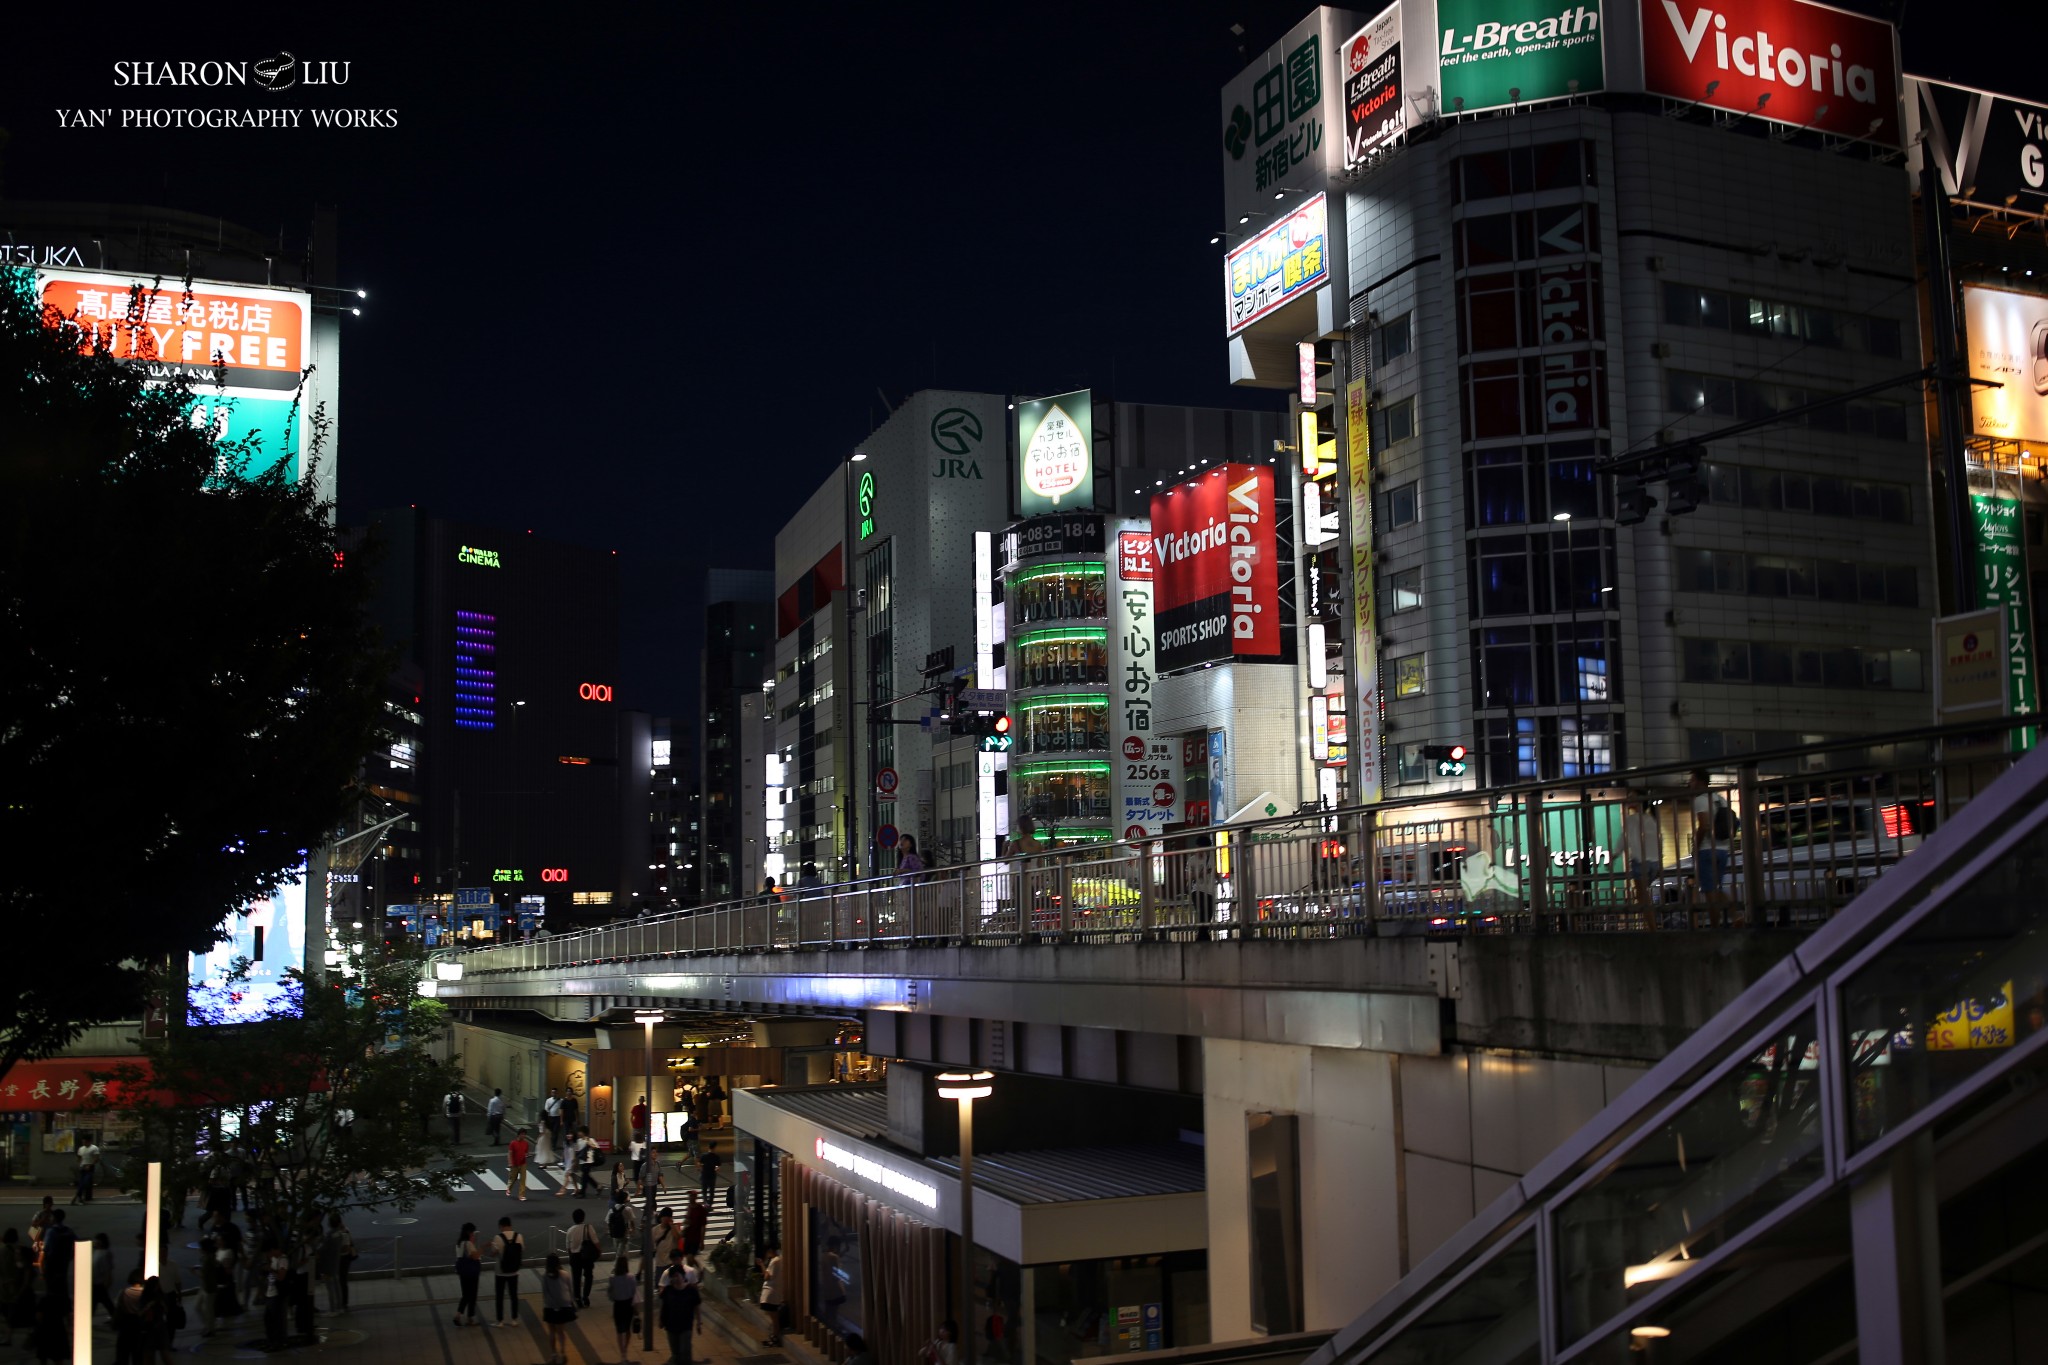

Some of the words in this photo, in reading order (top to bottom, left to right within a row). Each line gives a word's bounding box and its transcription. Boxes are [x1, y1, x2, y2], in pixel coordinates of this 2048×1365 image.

[1440, 53, 1459, 67] feel
[1462, 53, 1478, 64] the
[1481, 47, 1512, 60] earth,
[1515, 39, 1559, 56] open-air
[1562, 33, 1595, 48] sports
[1441, 6, 1598, 56] L-Breath
[1662, 0, 1875, 104] Victoria
[1253, 34, 1321, 148] 田園
[1351, 53, 1396, 98] L-Breath
[1351, 84, 1396, 123] Victoria
[1256, 117, 1323, 193] 新宿ビル
[1538, 208, 1590, 425] Victoria
[932, 459, 983, 480] JRA
[1035, 462, 1078, 477] HOTEL
[860, 517, 875, 541] JRA
[1976, 501, 2016, 518] フットジョイ
[458, 552, 501, 569] CINEMA
[1154, 516, 1227, 568] Victoria
[1228, 476, 1262, 639] Victoria
[1160, 623, 1198, 652] SPORTS
[1200, 614, 1228, 641] SHOP
[1122, 588, 1152, 731] 安心お宿
[1362, 688, 1375, 784] Victoria
[1126, 765, 1170, 780] 256室
[1125, 809, 1174, 821] タブレット
